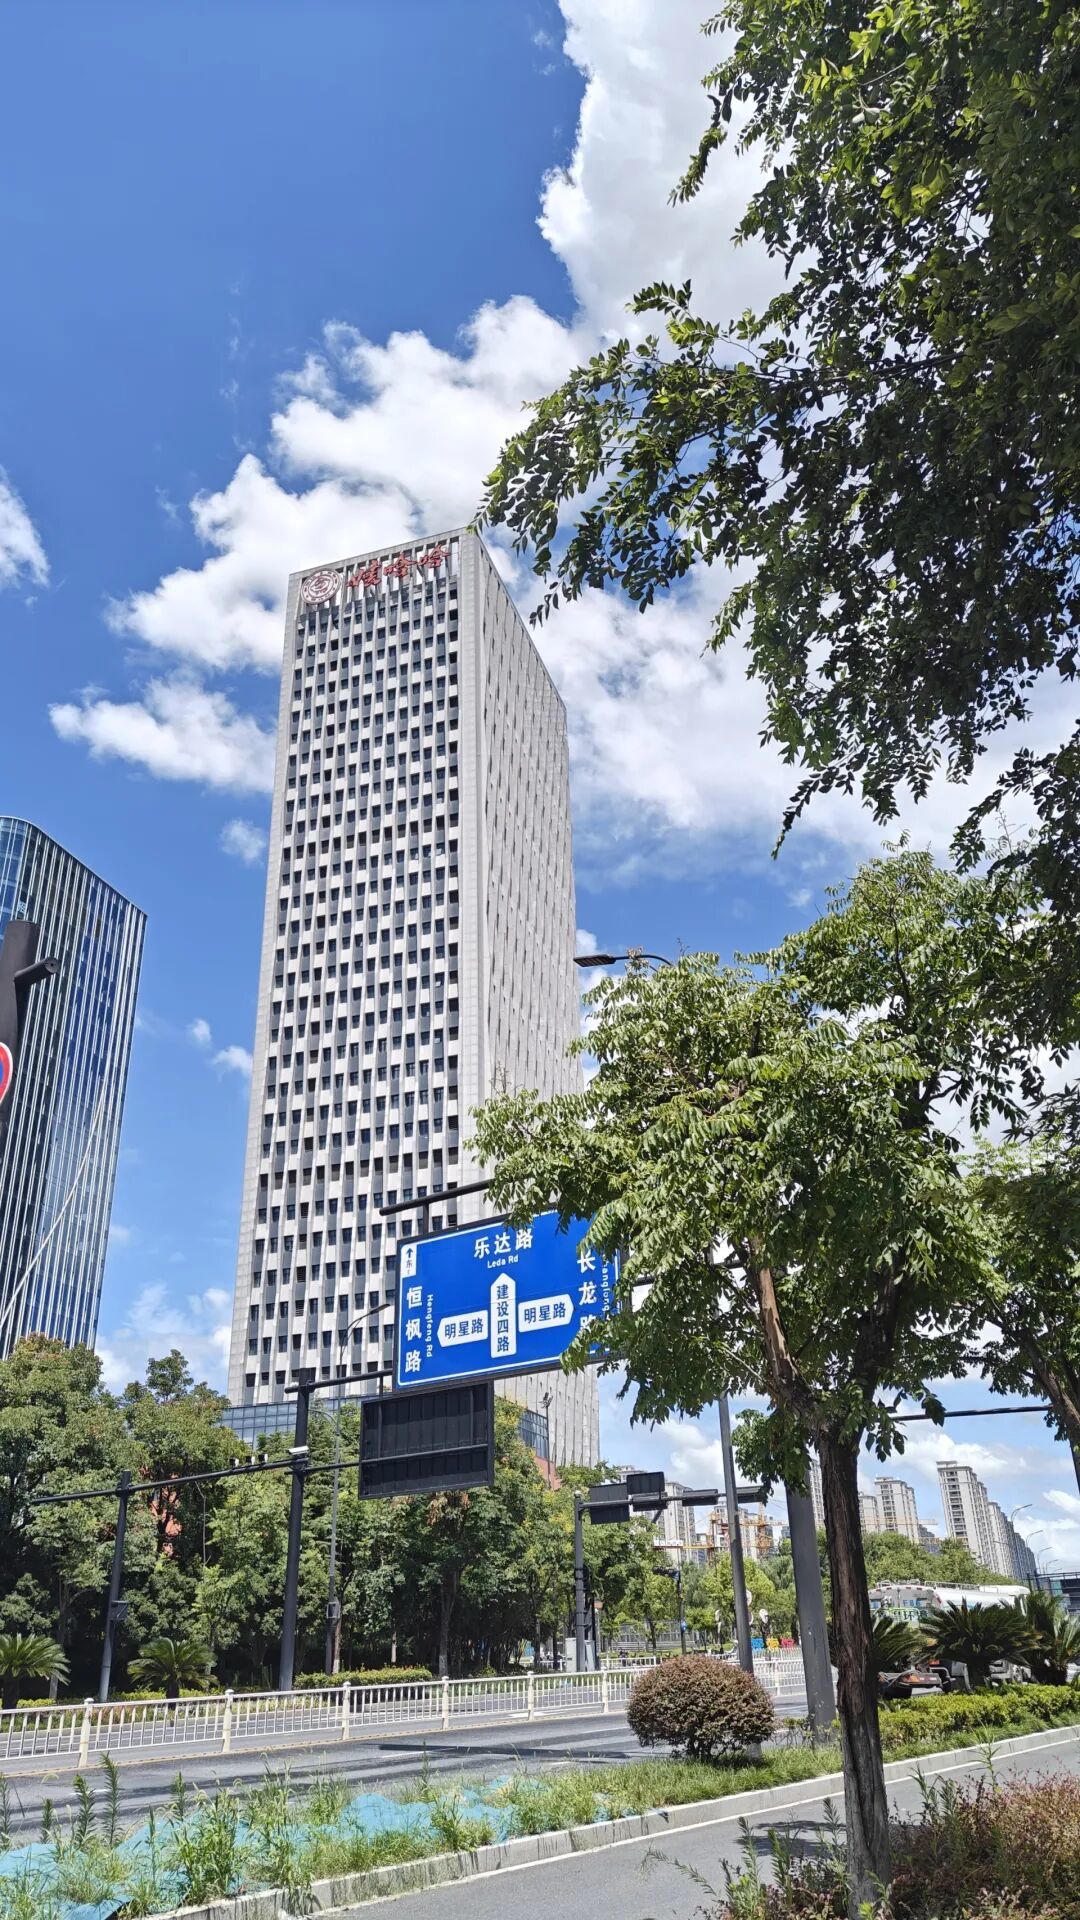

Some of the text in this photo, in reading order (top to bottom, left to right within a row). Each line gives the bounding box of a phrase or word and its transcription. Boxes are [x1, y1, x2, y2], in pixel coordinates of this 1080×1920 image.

[345, 543, 450, 588] 娃哈哈
[473, 1228, 534, 1259] 乐达路
[487, 1254, 519, 1269] Leda Rd
[405, 1285, 423, 1373] 恒枫路
[425, 1294, 434, 1358] Hengfeng Rd
[444, 1317, 484, 1339] 明星路
[496, 1284, 510, 1352] 建设四路
[524, 1301, 566, 1324] 明星路
